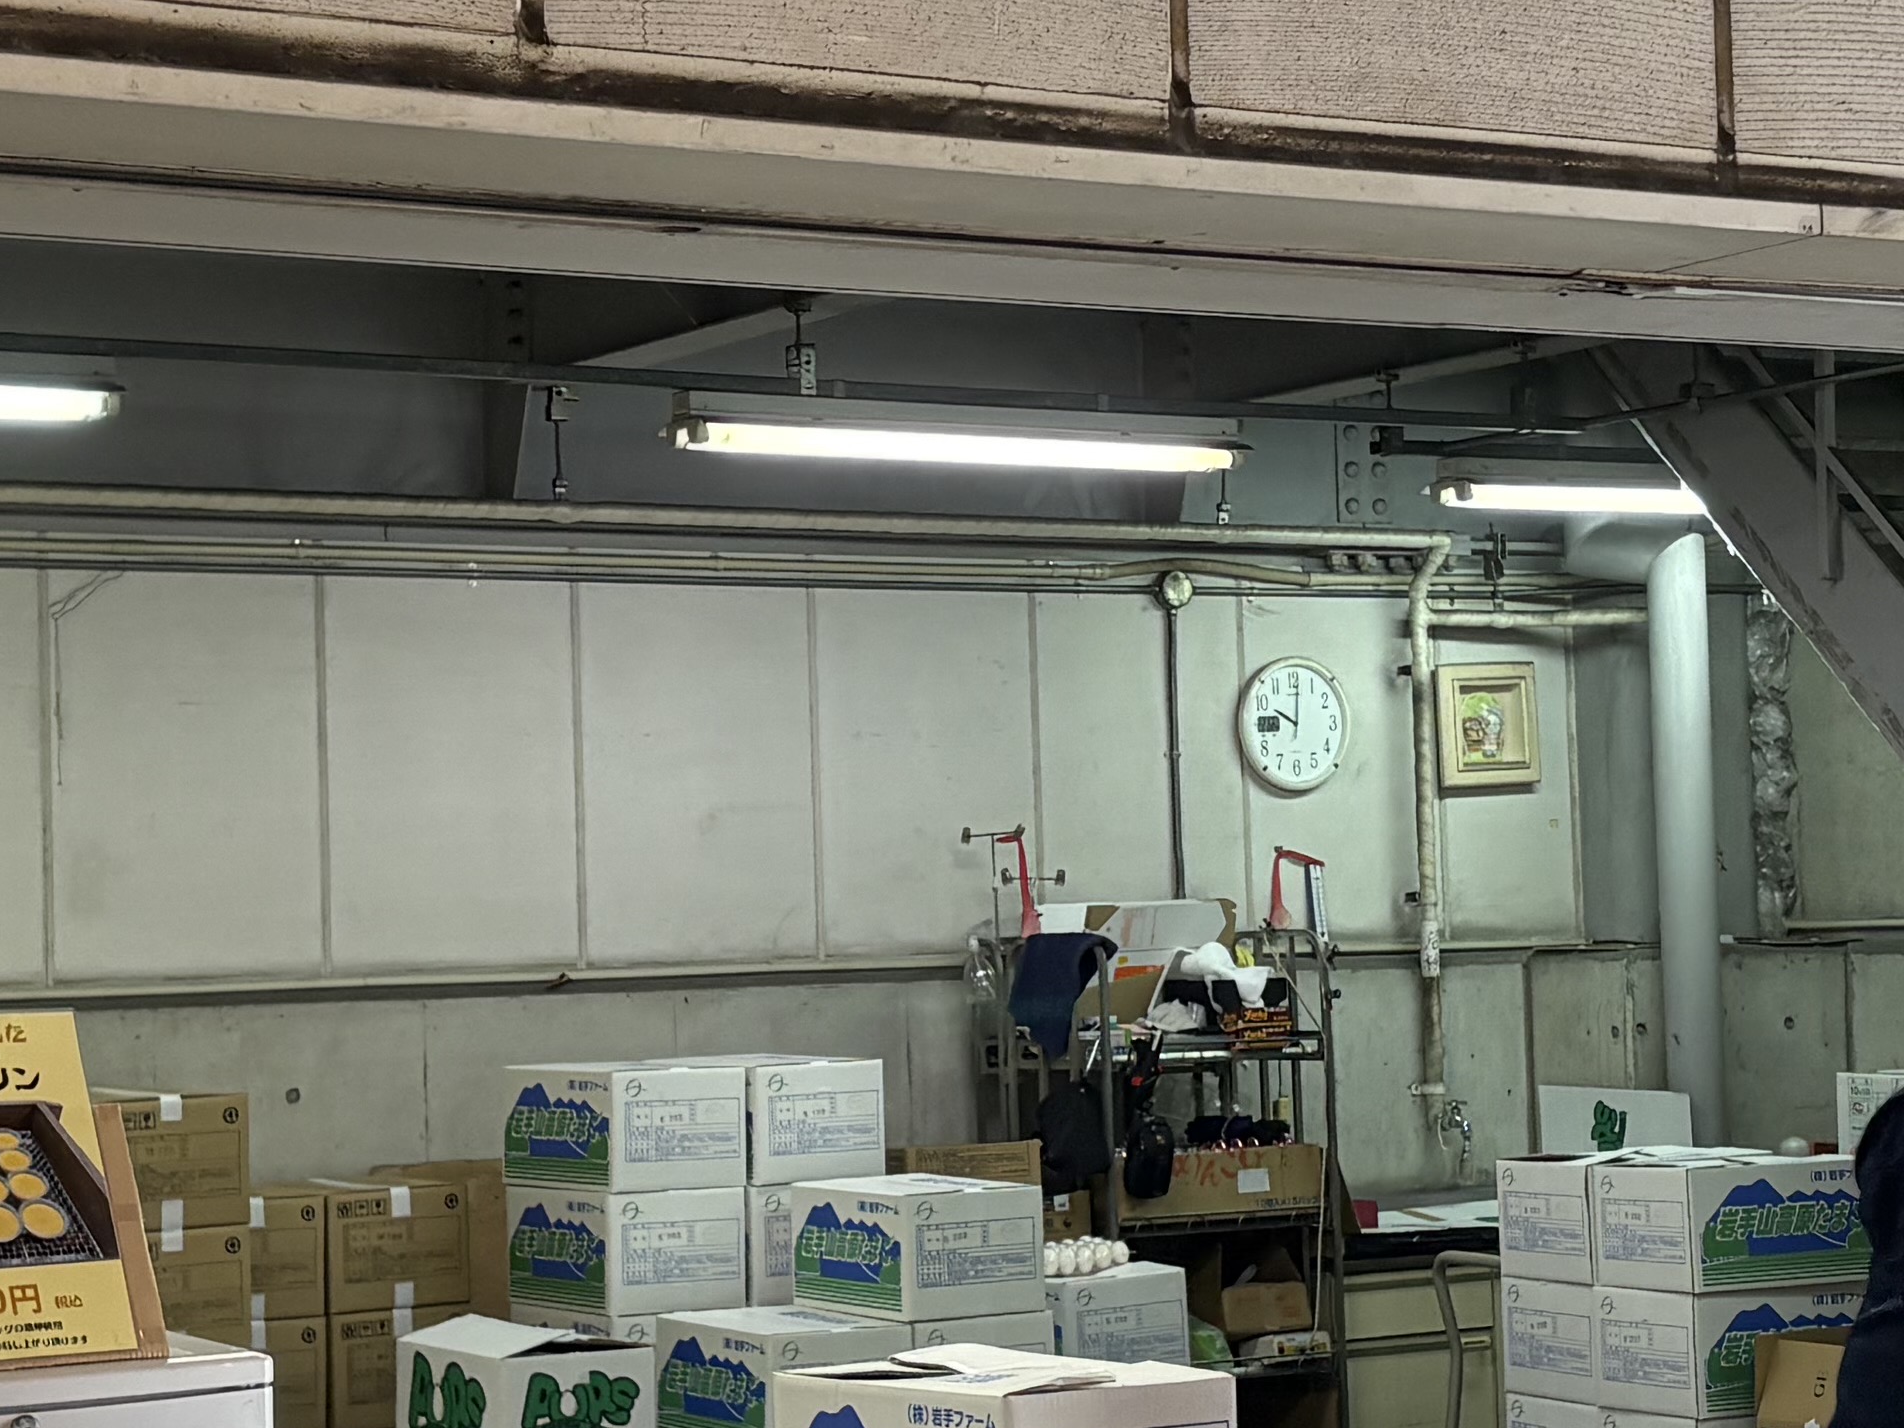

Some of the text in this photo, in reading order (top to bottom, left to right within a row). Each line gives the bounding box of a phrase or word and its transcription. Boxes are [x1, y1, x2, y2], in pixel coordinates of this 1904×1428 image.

[1272, 677, 1279, 695] 11
[1288, 671, 1299, 689] 12
[1256, 694, 1268, 711] 10
[1321, 692, 1328, 709] 2
[1329, 714, 1337, 731] 3
[1260, 740, 1269, 757] 8
[1323, 737, 1330, 754] 4
[1276, 753, 1284, 771] 7
[1293, 759, 1301, 776] 6
[1310, 752, 1318, 769] 5
